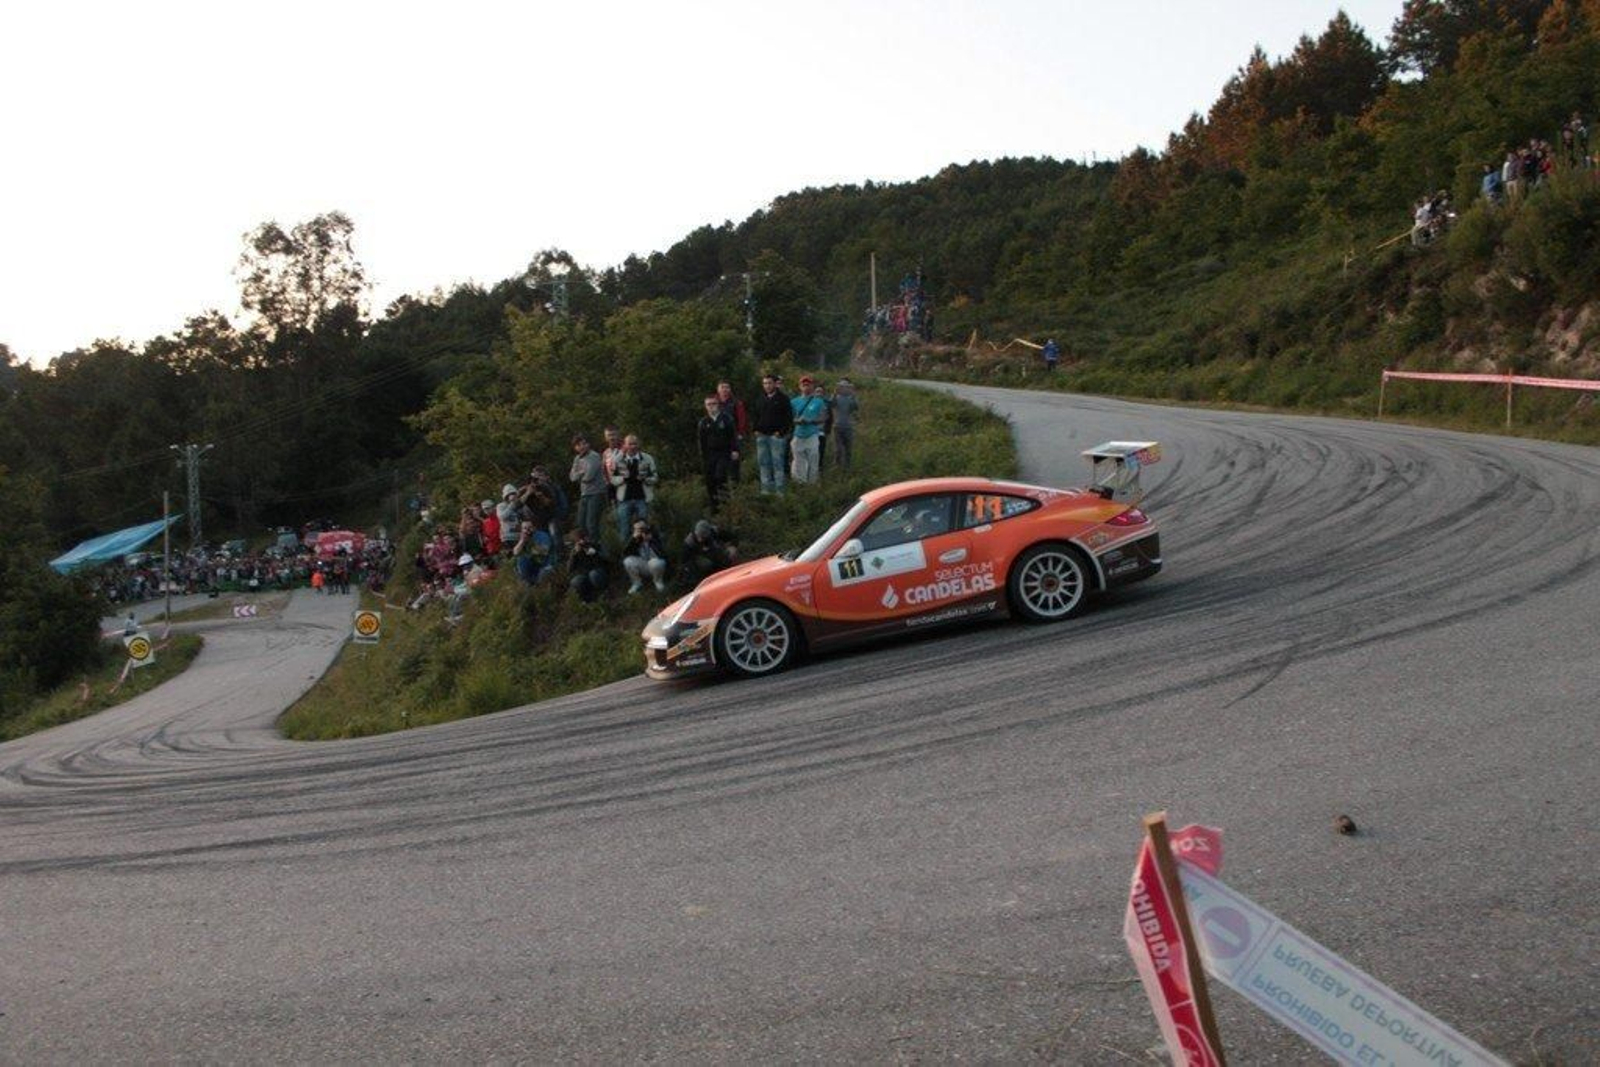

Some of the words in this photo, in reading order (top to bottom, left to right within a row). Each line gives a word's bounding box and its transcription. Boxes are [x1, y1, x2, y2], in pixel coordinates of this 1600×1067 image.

[843, 559, 860, 577] 11
[905, 573, 996, 604] CANDELAS
[1132, 878, 1171, 973] OHIBIDA
